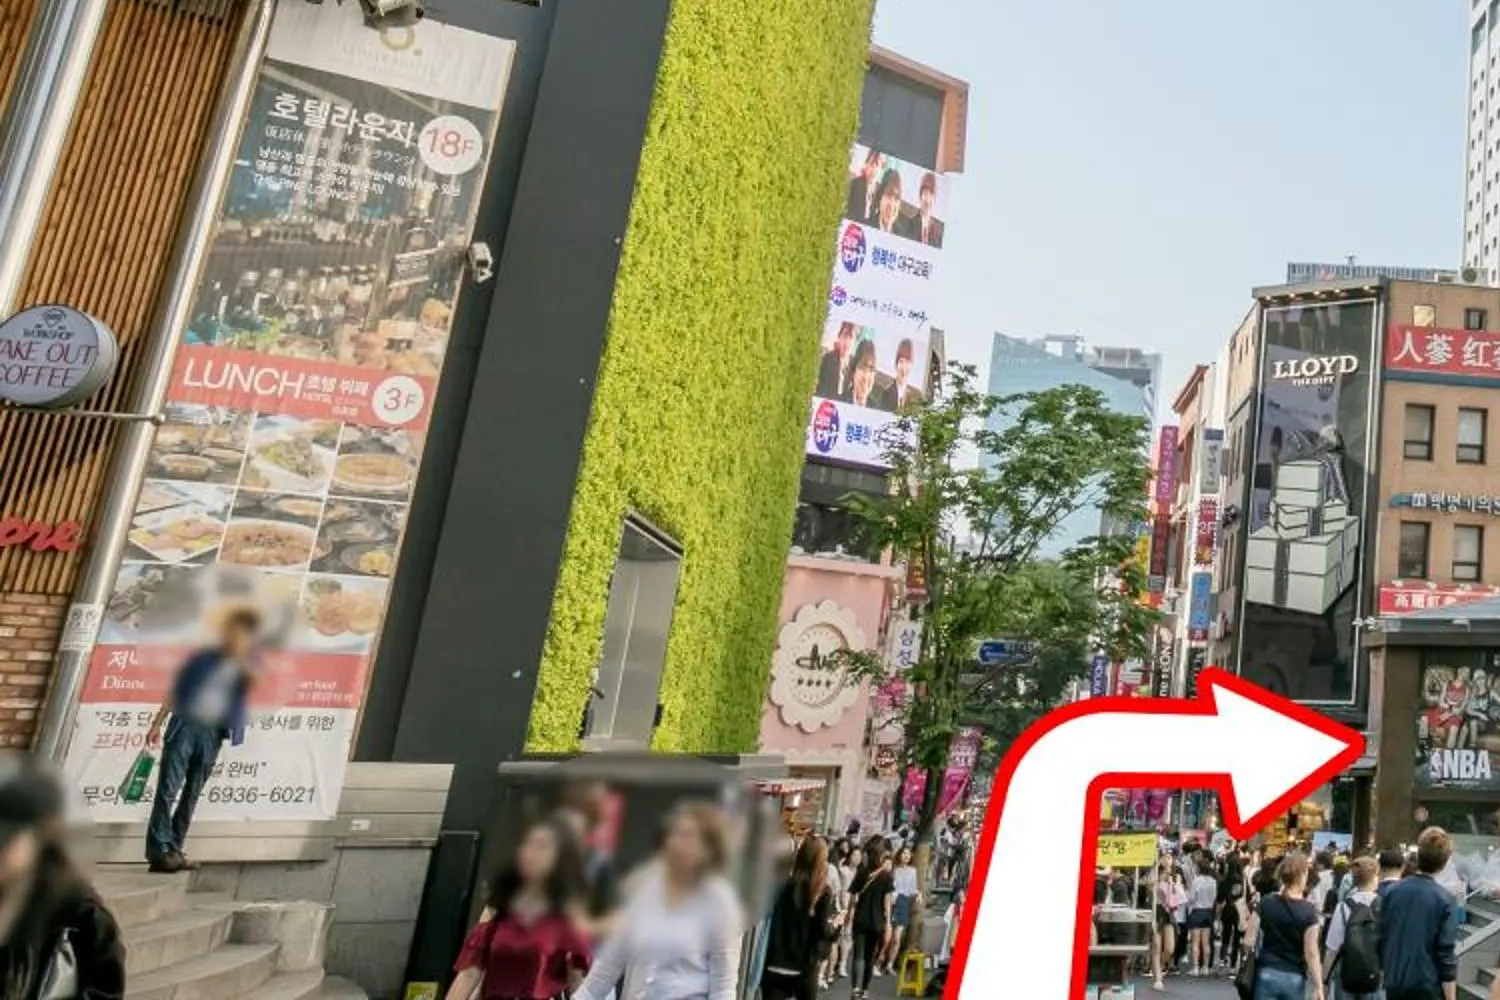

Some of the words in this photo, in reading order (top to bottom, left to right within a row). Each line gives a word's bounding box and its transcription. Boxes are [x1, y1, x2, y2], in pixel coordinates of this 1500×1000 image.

[266, 92, 419, 149] 호텔라운지
[425, 128, 476, 159] 18F
[0, 340, 42, 361] AKE
[46, 342, 97, 365] OUT
[183, 357, 306, 399] LUNCH
[1272, 354, 1358, 380] LLOYD
[383, 386, 417, 412] 3F
[306, 716, 336, 731] 위한
[1443, 749, 1492, 779] NBA
[199, 785, 318, 804] -6936-6021
